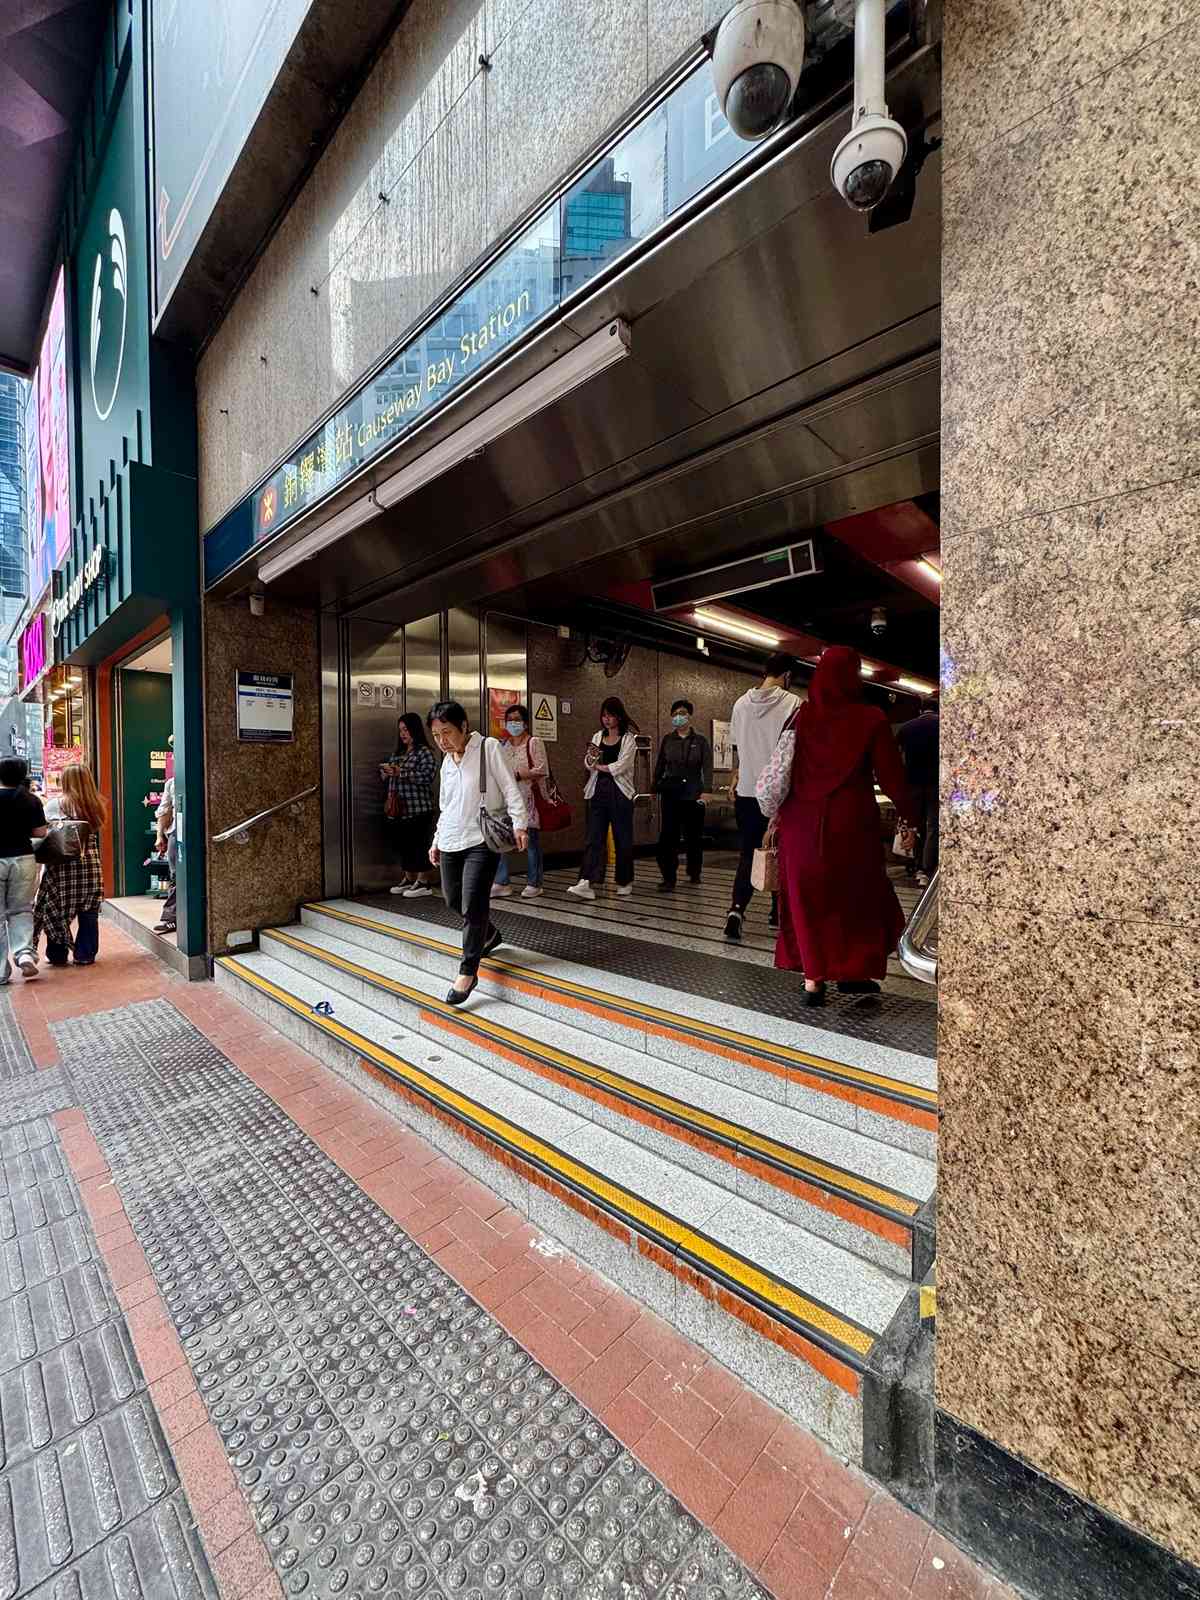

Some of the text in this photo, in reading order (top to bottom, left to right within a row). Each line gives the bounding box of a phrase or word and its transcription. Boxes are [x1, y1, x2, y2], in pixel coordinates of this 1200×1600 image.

[357, 289, 530, 447] Causeway Bay Station
[84, 544, 102, 589] SHOP
